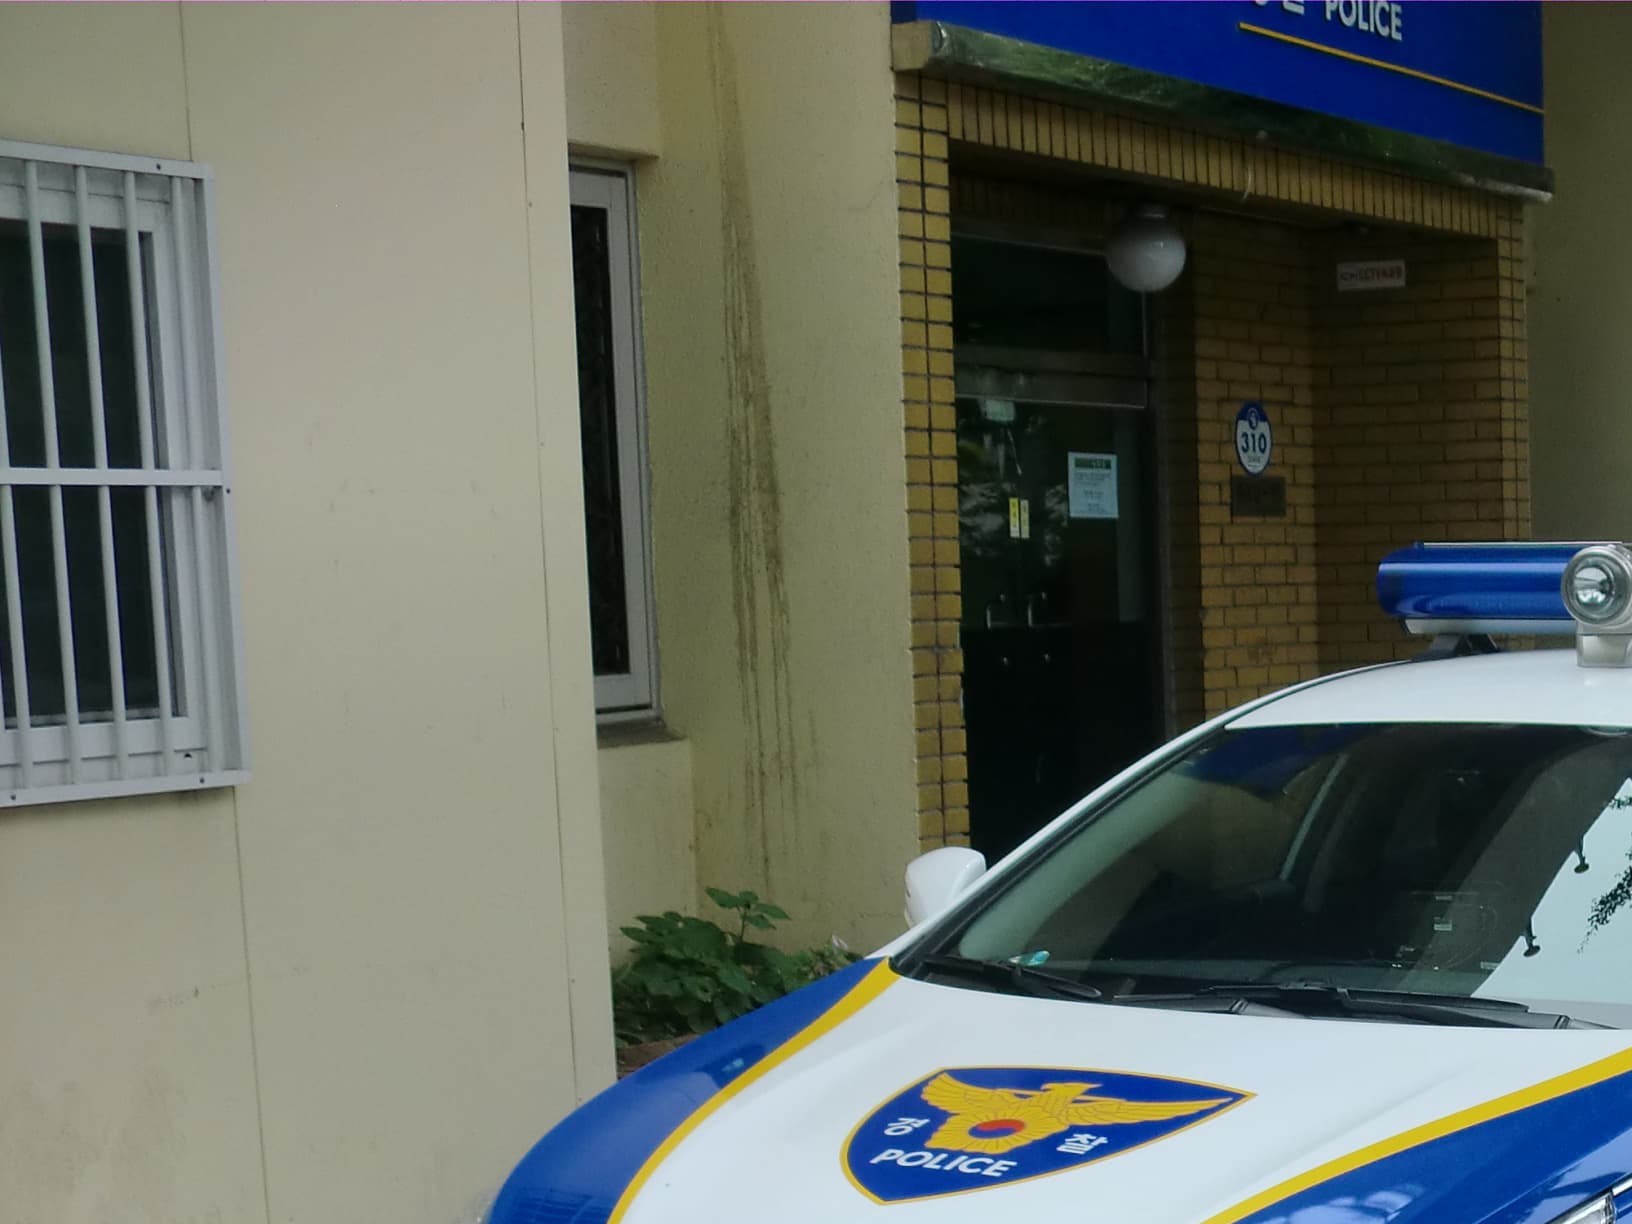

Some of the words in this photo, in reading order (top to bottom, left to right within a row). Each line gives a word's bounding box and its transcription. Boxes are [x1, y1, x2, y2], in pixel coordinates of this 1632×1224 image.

[1325, 0, 1403, 41] POLICE
[1241, 431, 1267, 454] 310
[869, 1149, 1017, 1177] POLICE
